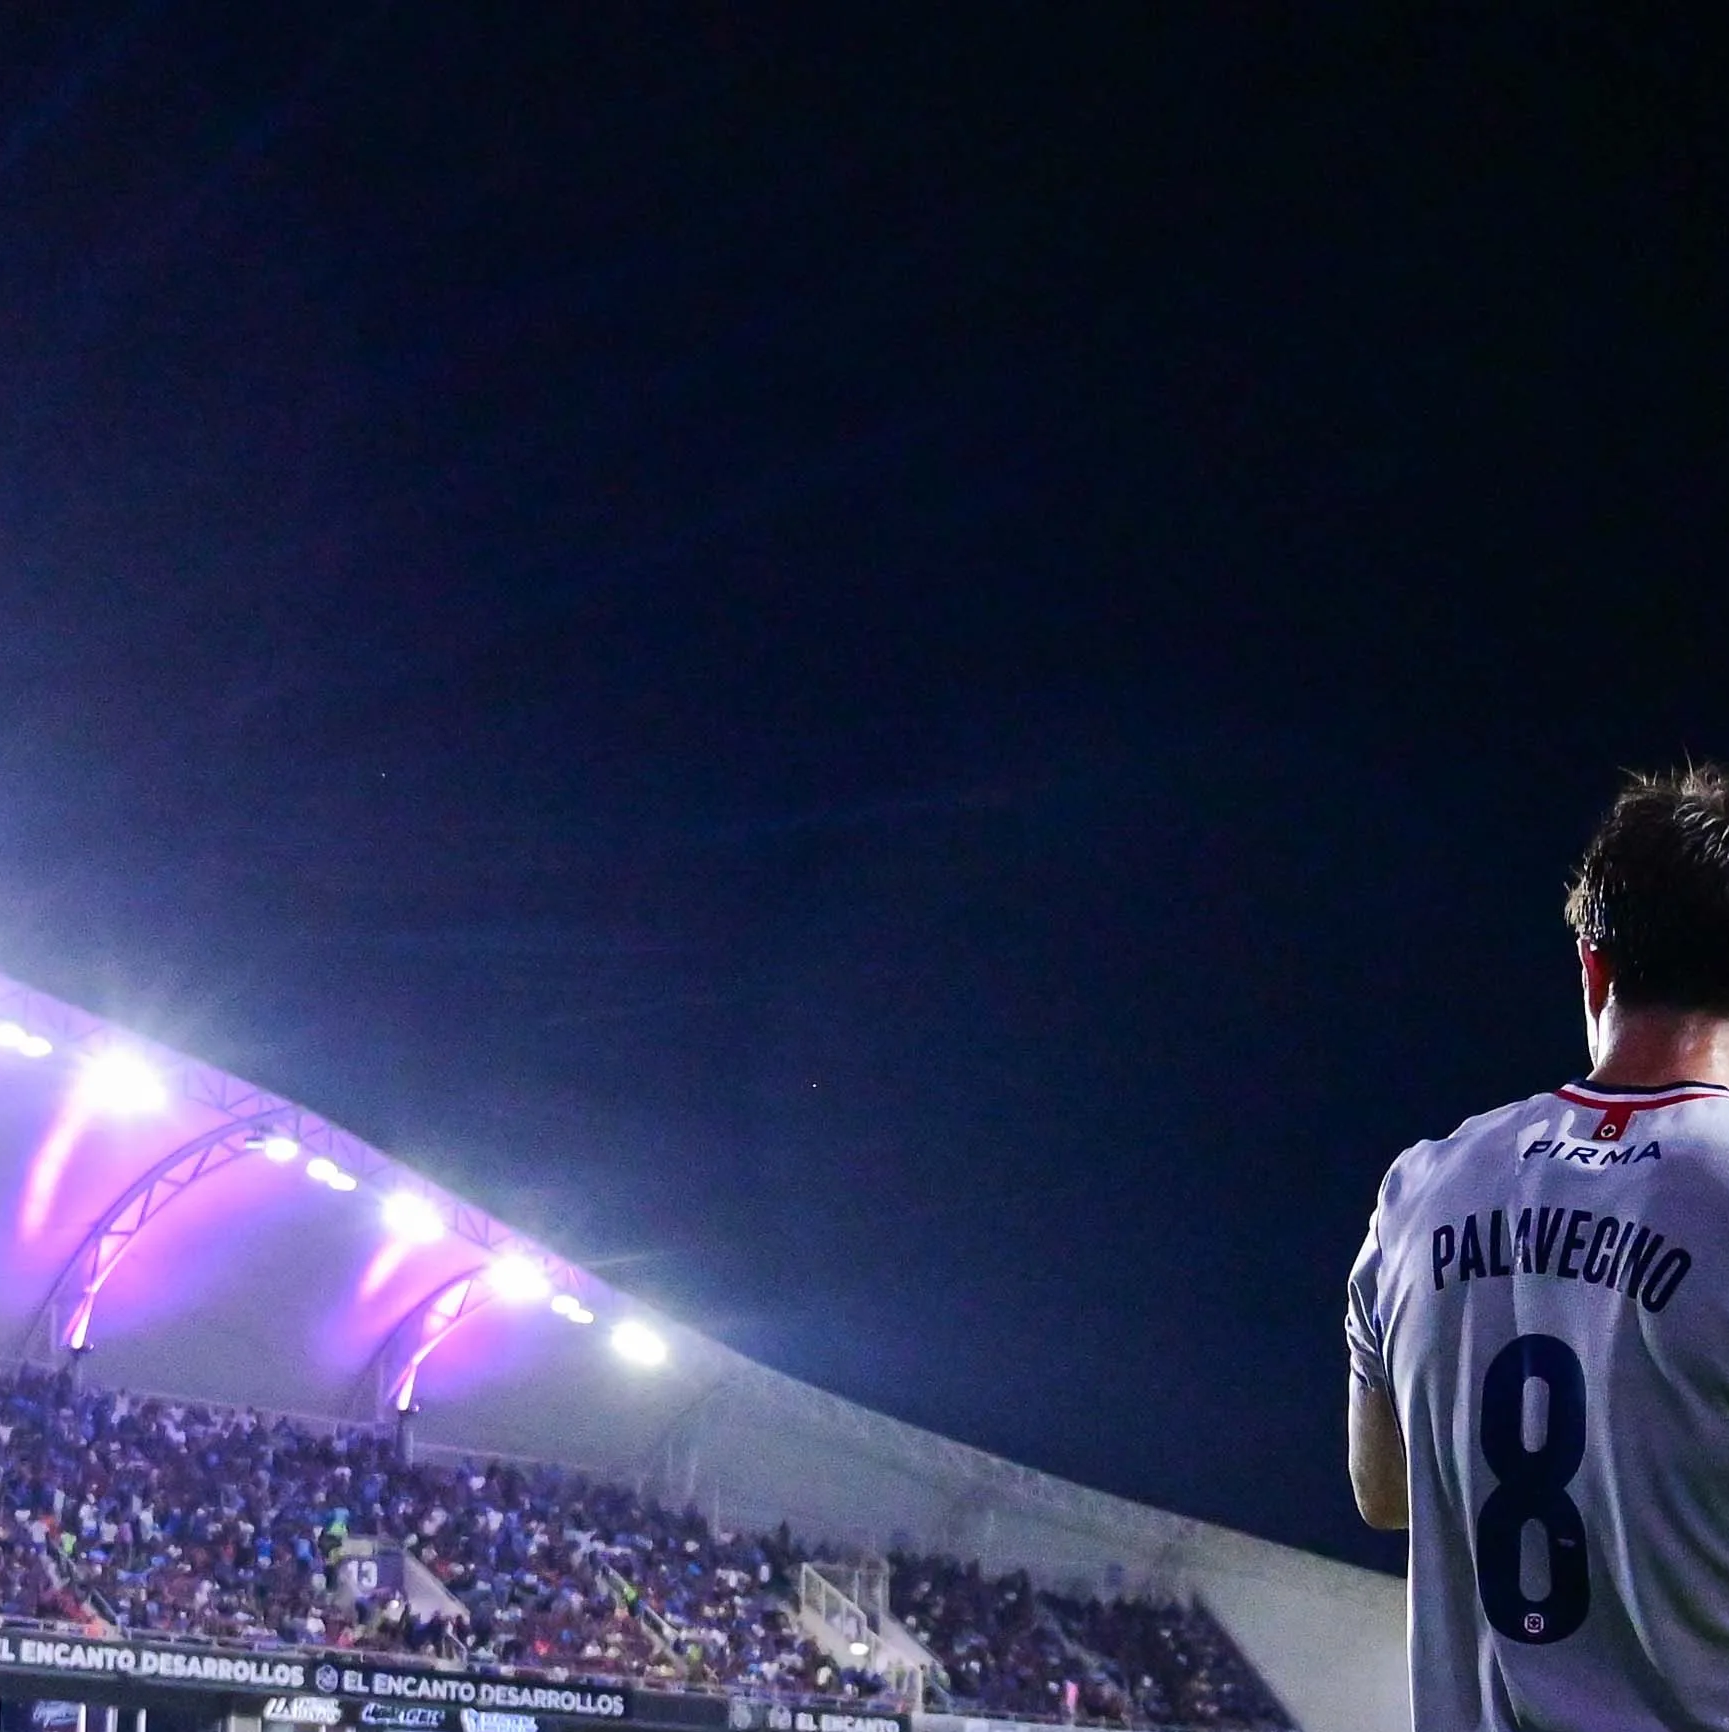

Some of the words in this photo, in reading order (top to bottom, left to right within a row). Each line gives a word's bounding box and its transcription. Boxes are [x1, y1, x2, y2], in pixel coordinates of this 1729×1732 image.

[1523, 1140, 1661, 1165] PIRMA
[1433, 1207, 1691, 1313] PALAVECINO
[1476, 1333, 1592, 1644] 8
[20, 1639, 136, 1673] ENCANTO
[142, 1652, 304, 1688] DESARROLLOS
[344, 1671, 369, 1693] EL
[373, 1673, 475, 1702] ENCANTO
[480, 1683, 624, 1717] DESARROLLOS
